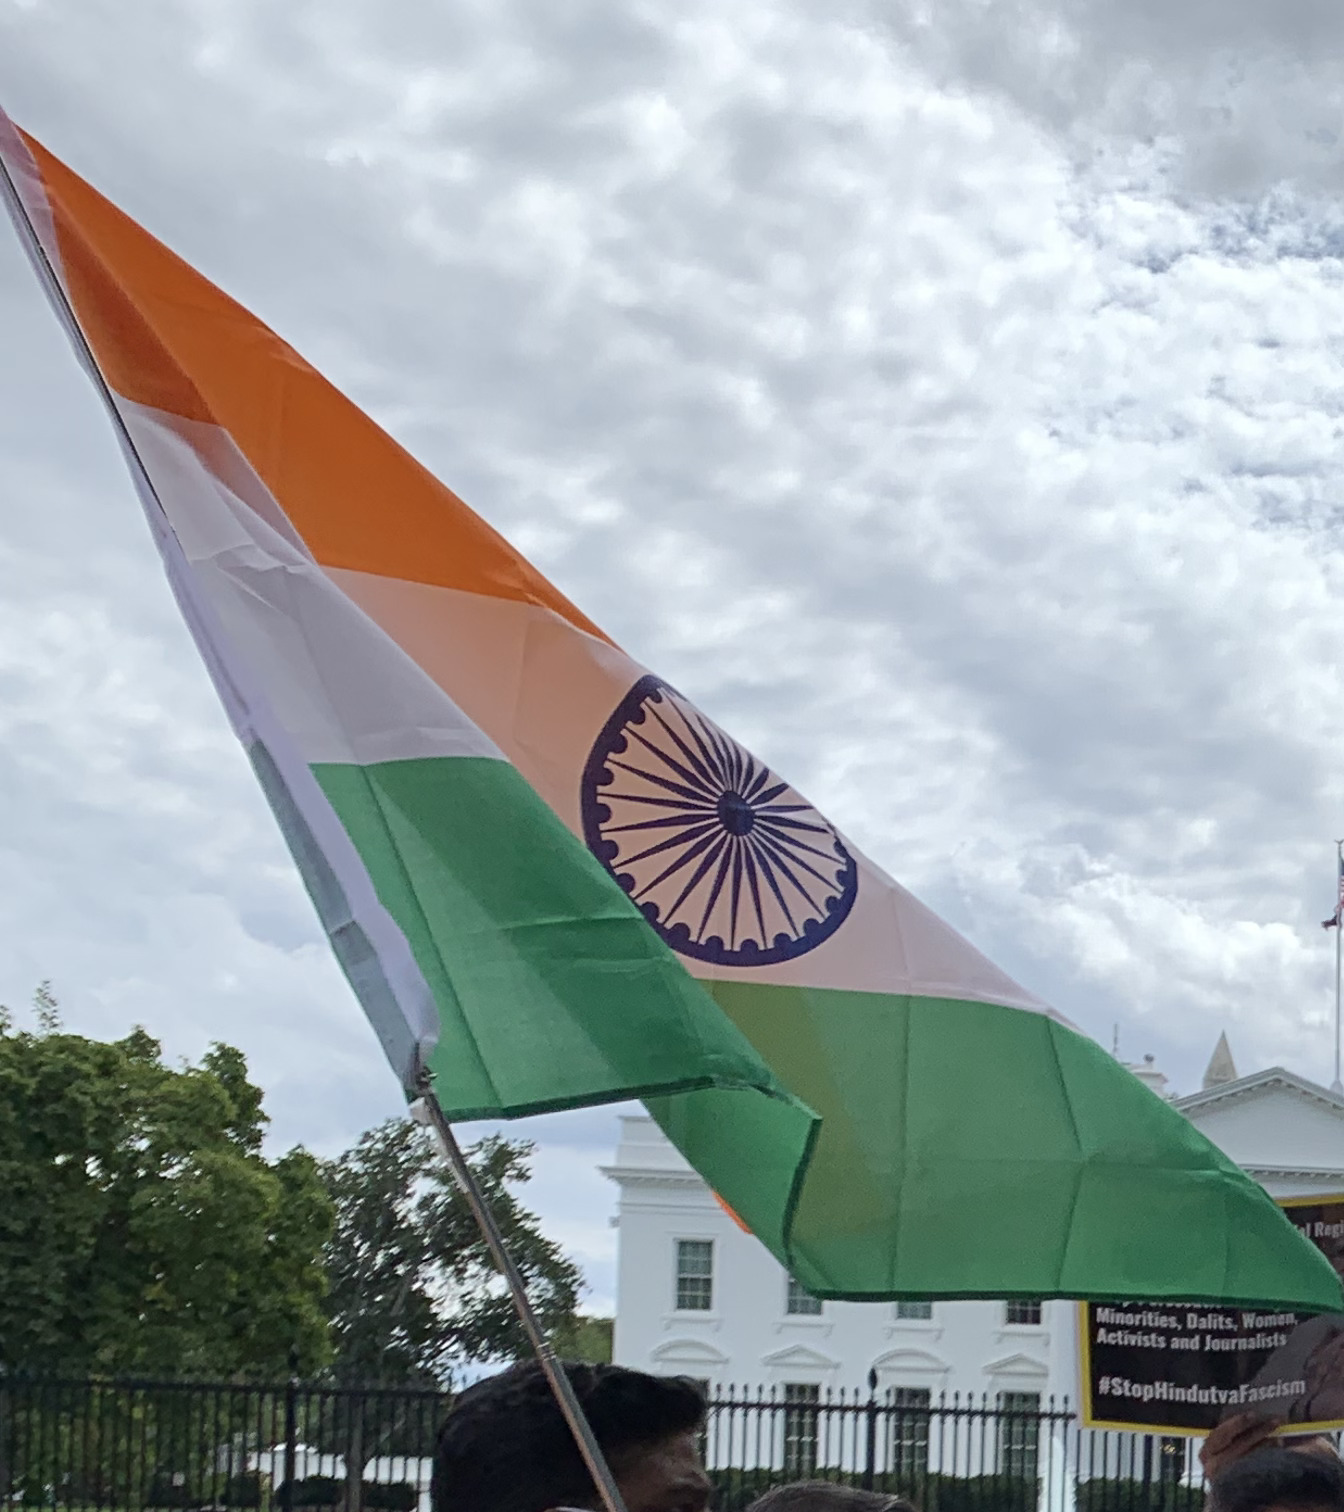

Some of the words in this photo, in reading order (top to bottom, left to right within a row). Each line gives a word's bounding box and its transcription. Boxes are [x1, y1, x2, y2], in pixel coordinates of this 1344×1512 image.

[1096, 1307, 1181, 1330] Minorities,
[1186, 1313, 1238, 1332] Dalits,
[1241, 1312, 1299, 1329] Women,
[1097, 1328, 1166, 1349] Activists
[1171, 1334, 1199, 1350] and
[1204, 1332, 1287, 1351] Journalists
[1099, 1376, 1305, 1404] #StopHindutvaFascism
